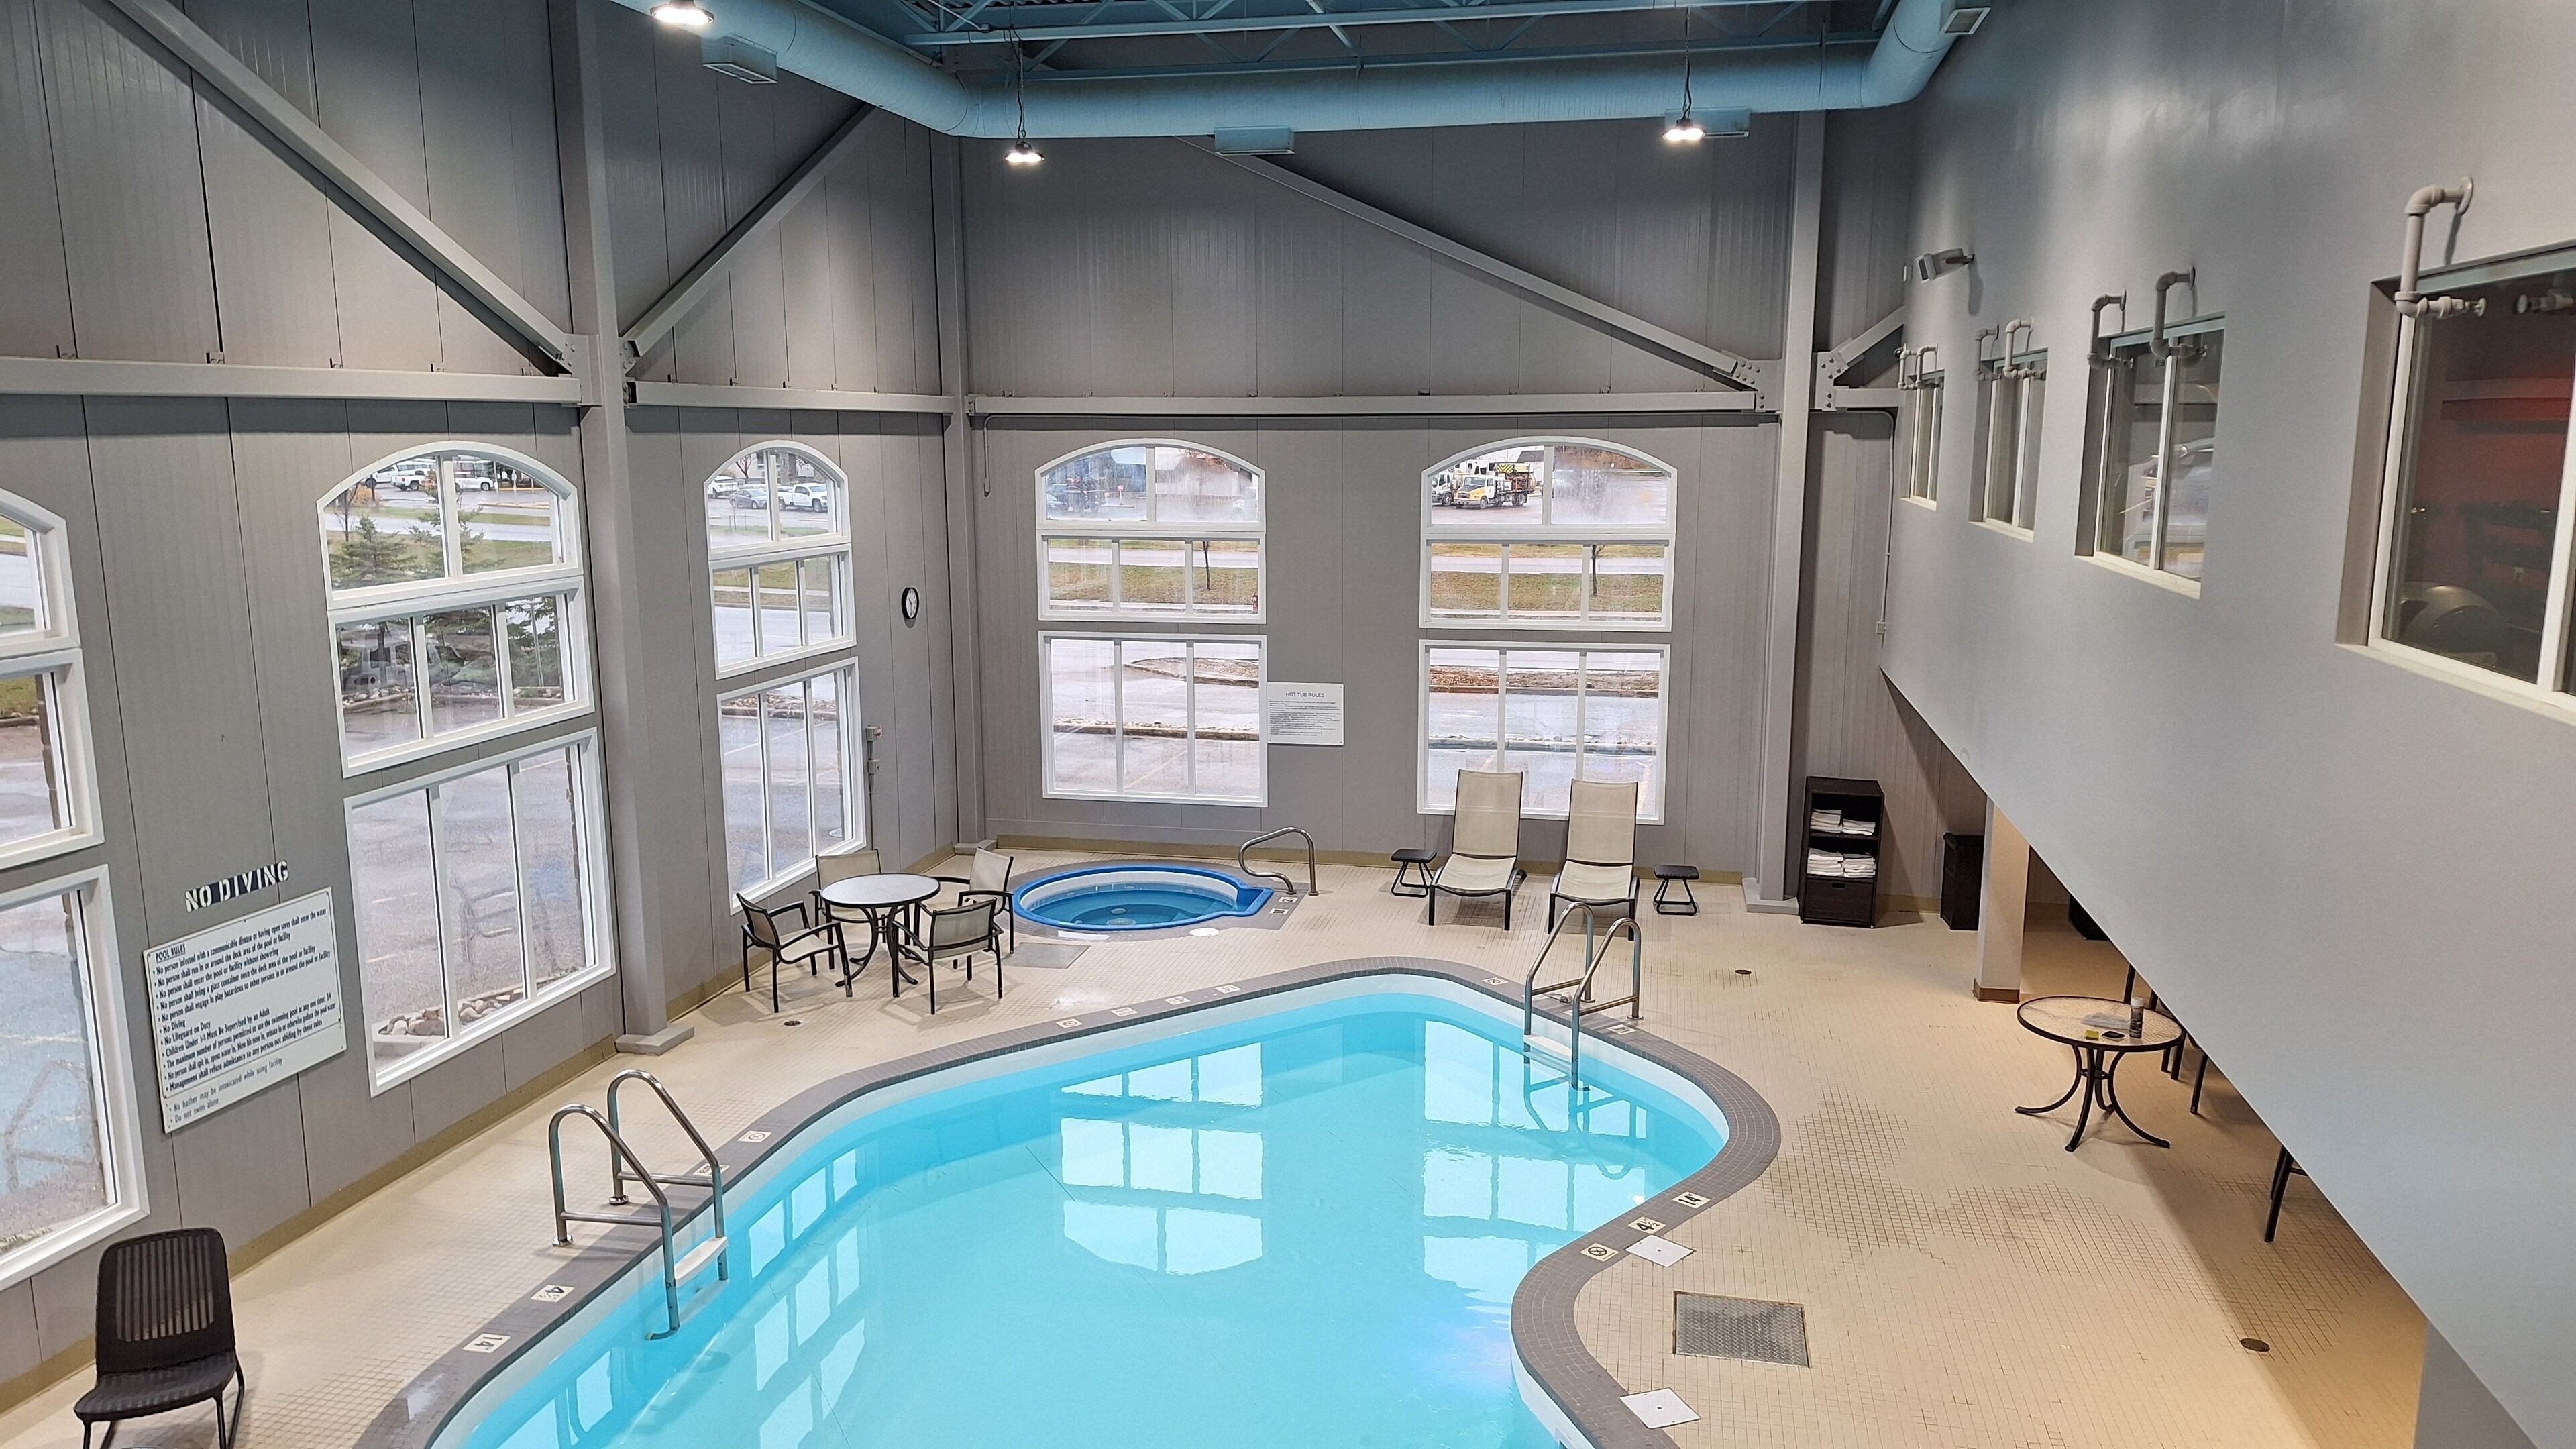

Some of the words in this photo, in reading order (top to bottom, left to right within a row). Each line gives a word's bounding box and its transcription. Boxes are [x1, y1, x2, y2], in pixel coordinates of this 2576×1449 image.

[184, 885, 212, 913] NO
[219, 860, 288, 902] DIVING
[156, 966, 163, 975] No
[164, 962, 179, 975] person
[179, 953, 196, 967] infected
[197, 950, 206, 961] with
[239, 935, 252, 945] disease
[258, 928, 270, 938] having
[271, 925, 280, 934] open
[281, 921, 290, 930] sores
[291, 916, 299, 926] shall
[300, 914, 309, 923] enter
[317, 908, 326, 917] water
[156, 949, 170, 961] POOL
[170, 943, 186, 956] RULES
[158, 978, 165, 987] No
[166, 973, 180, 986] person
[181, 967, 191, 979] shall
[199, 963, 204, 972] in
[211, 955, 224, 967] around
[232, 949, 241, 959] deck
[243, 947, 251, 956] area
[252, 943, 256, 953] of
[264, 937, 272, 949] pool
[278, 932, 290, 943] facility
[159, 989, 166, 999] No
[167, 985, 182, 998] person
[183, 979, 193, 990] shall
[193, 976, 204, 986] enter
[213, 967, 223, 980] pool
[229, 961, 243, 972] facility
[244, 955, 259, 967] without
[260, 947, 279, 961] showering
[160, 1002, 168, 1010] No
[168, 997, 183, 1010] person
[184, 990, 194, 1002] shall
[194, 987, 206, 998] bring
[210, 982, 220, 994] glass
[221, 975, 239, 987] container
[258, 963, 267, 973] deck
[268, 961, 276, 969] area
[277, 957, 281, 966] of
[289, 951, 298, 963] pool
[303, 945, 315, 955] facility
[161, 1013, 168, 1022] No
[169, 1008, 184, 1021] person
[184, 1002, 195, 1014] shall
[195, 999, 209, 1009] engage
[209, 995, 214, 1004] in
[215, 992, 223, 1003] play
[250, 978, 260, 988] other
[260, 973, 275, 985] persons
[275, 969, 280, 978] in
[286, 961, 298, 974] around
[305, 955, 313, 967] pool
[319, 950, 330, 961] facility
[162, 1025, 170, 1034] No
[171, 1019, 186, 1031] Diving
[164, 1036, 172, 1045] No
[172, 1026, 193, 1042] Lifeguard
[200, 1022, 211, 1031] Duty
[166, 1044, 184, 1057] Children
[184, 1038, 198, 1049] Under
[207, 1030, 217, 1040] Must
[218, 1026, 224, 1035] Be
[225, 1017, 246, 1033] Supervised
[246, 1016, 252, 1024] by
[259, 1008, 270, 1018] Adult
[166, 1059, 174, 1069] The
[213, 1040, 217, 1050] of
[217, 1036, 233, 1049] persons
[233, 1026, 252, 1042] permitted
[289, 1006, 298, 1018] pool
[167, 1072, 174, 1080] No
[174, 1067, 187, 1079] person
[188, 1061, 197, 1071] shall
[221, 1048, 231, 1057] water
[252, 1036, 260, 1044] nose
[278, 1025, 282, 1033] in
[327, 1003, 336, 1011] water
[169, 1074, 198, 1091] Management
[199, 1067, 209, 1079] shall
[209, 1063, 222, 1074] refuse
[260, 1041, 274, 1054] person
[297, 1028, 302, 1036] by
[303, 1024, 313, 1033] these
[313, 1019, 323, 1028] rules
[174, 1104, 180, 1112] No
[182, 1096, 197, 1108] bather
[199, 1091, 209, 1100] may
[211, 1087, 216, 1095] be
[244, 1069, 254, 1080] while
[268, 1058, 282, 1068] facility
[174, 1114, 182, 1123] Do
[184, 1110, 192, 1119] not
[193, 1104, 205, 1115] swim
[207, 1098, 219, 1108] alone
